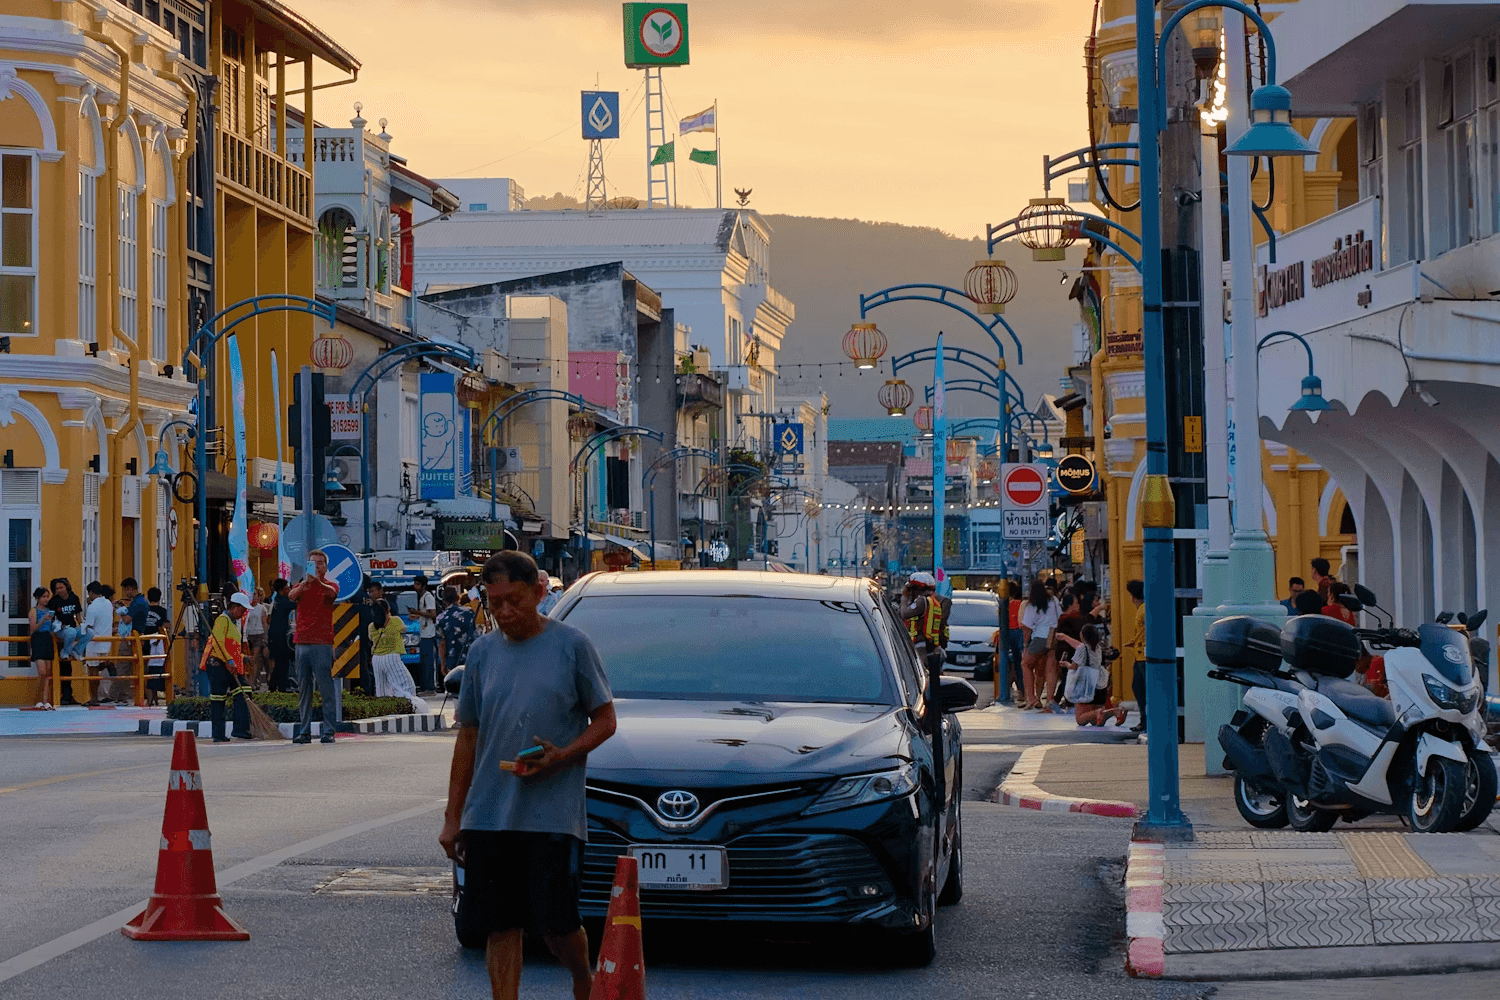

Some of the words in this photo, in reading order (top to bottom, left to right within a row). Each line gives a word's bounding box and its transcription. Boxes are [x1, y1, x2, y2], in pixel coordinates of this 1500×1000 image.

[335, 401, 345, 414] FOR
[419, 472, 455, 481] JUITEE
[1006, 512, 1045, 526] ห้ามเข้า
[1272, 692, 1294, 705] POLICE
[641, 852, 666, 869] กก
[688, 853, 706, 870] 11
